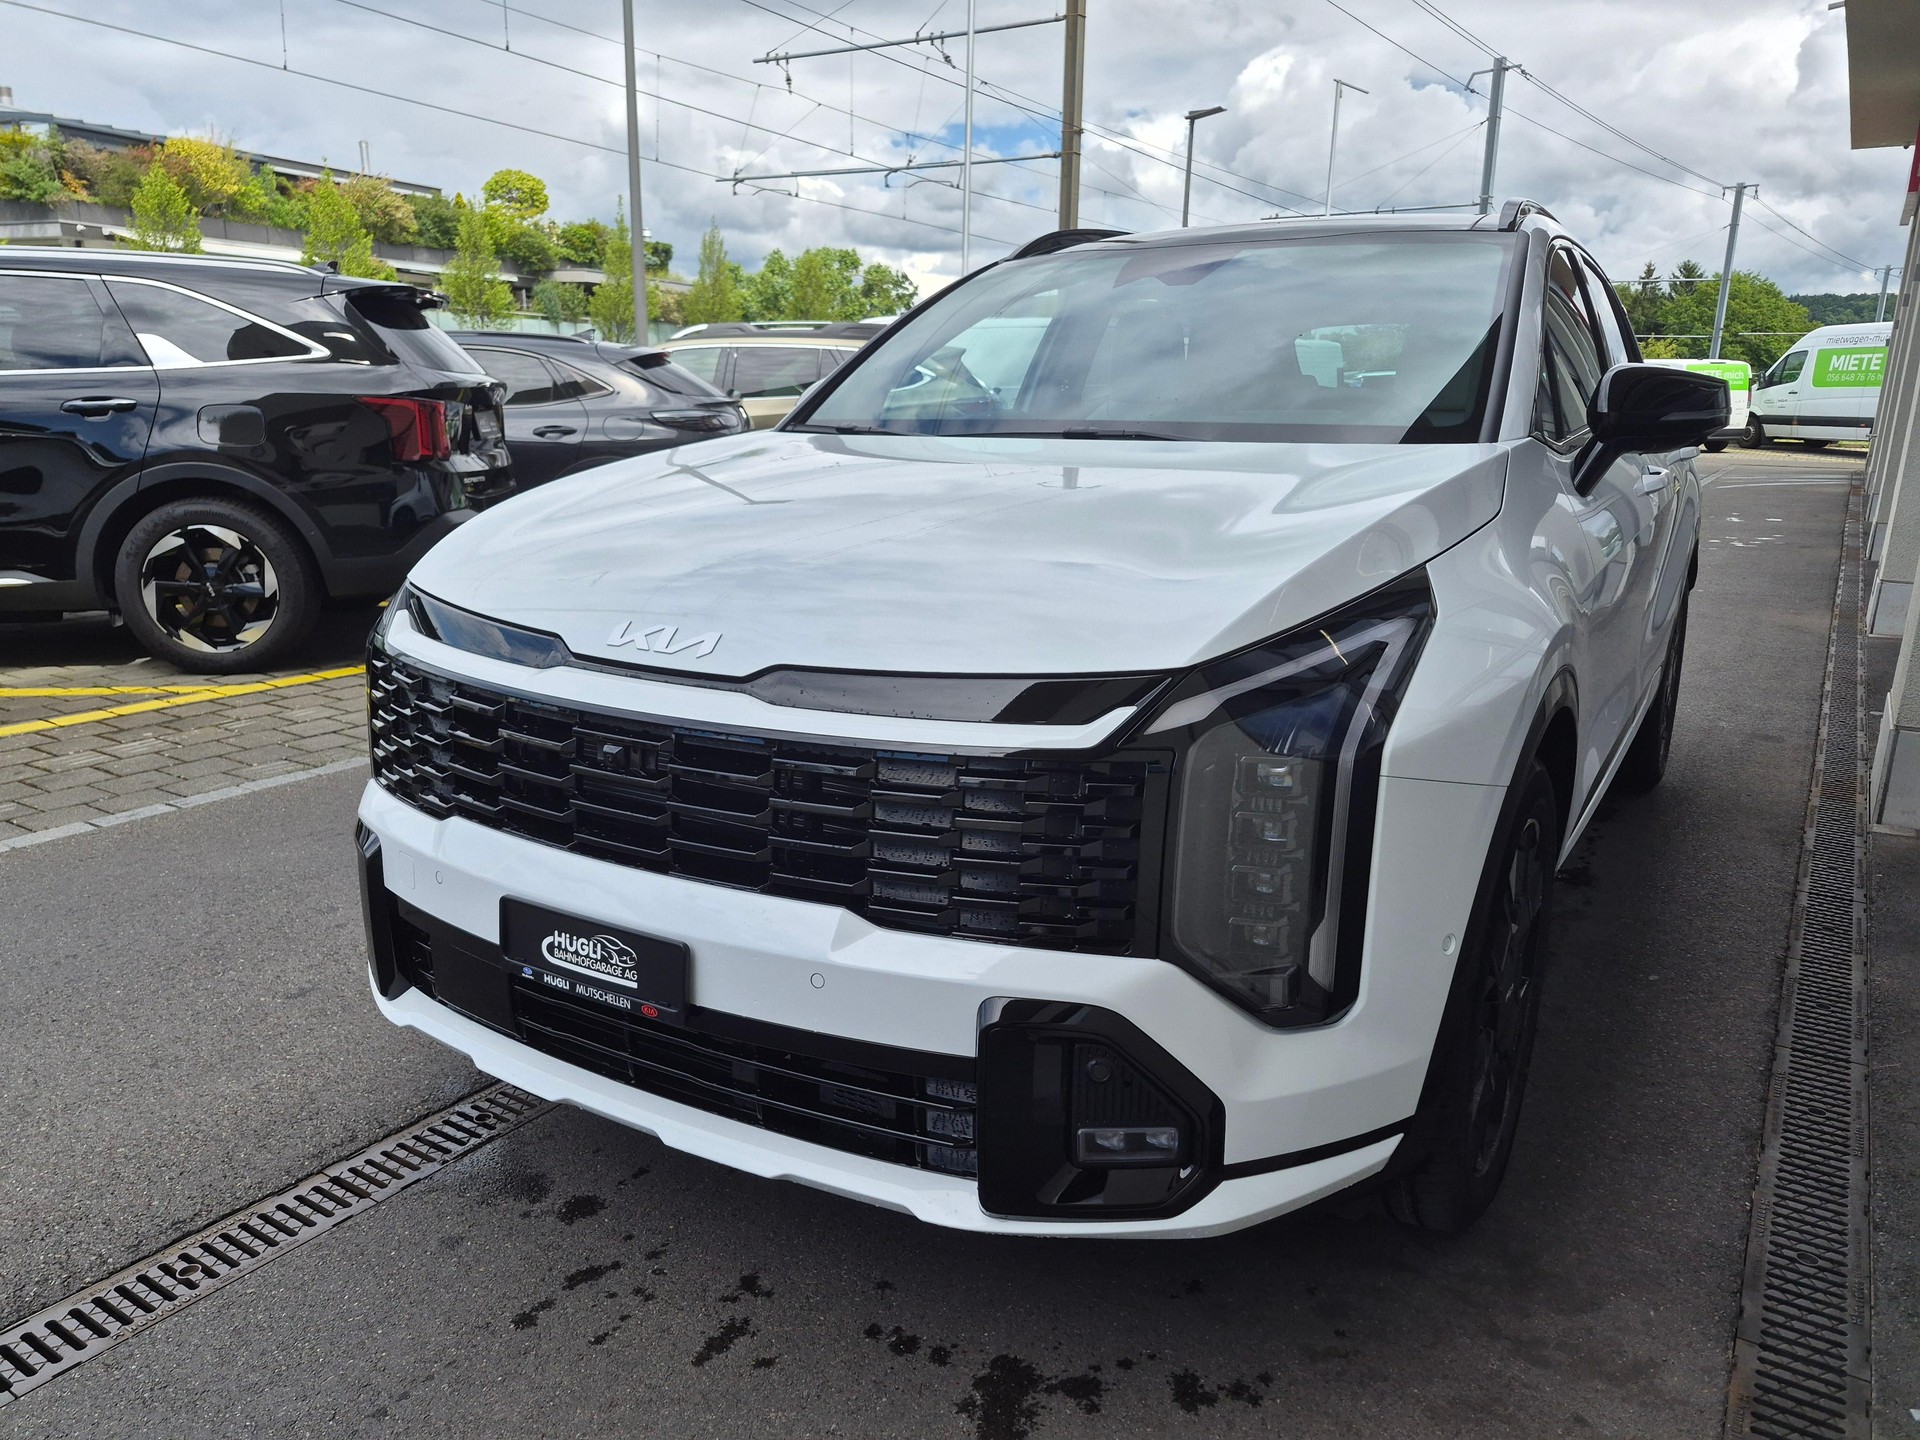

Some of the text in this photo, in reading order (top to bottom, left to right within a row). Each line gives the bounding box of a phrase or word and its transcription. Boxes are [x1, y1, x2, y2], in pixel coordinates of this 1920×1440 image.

[1724, 370, 1744, 379] mich
[1826, 373, 1839, 381] 056
[1841, 373, 1855, 381] 648
[1856, 373, 1865, 381] 76
[1866, 372, 1875, 380] 76
[1829, 353, 1883, 371] MIETE
[606, 620, 723, 659] KIA
[554, 930, 601, 959] HÜGLI
[554, 948, 638, 981] BAHNHOFGARAGE AG
[576, 983, 631, 1009] MUTSCHELLEN
[642, 1005, 657, 1016] KIA
[126, 1292, 201, 1333] hauraton
